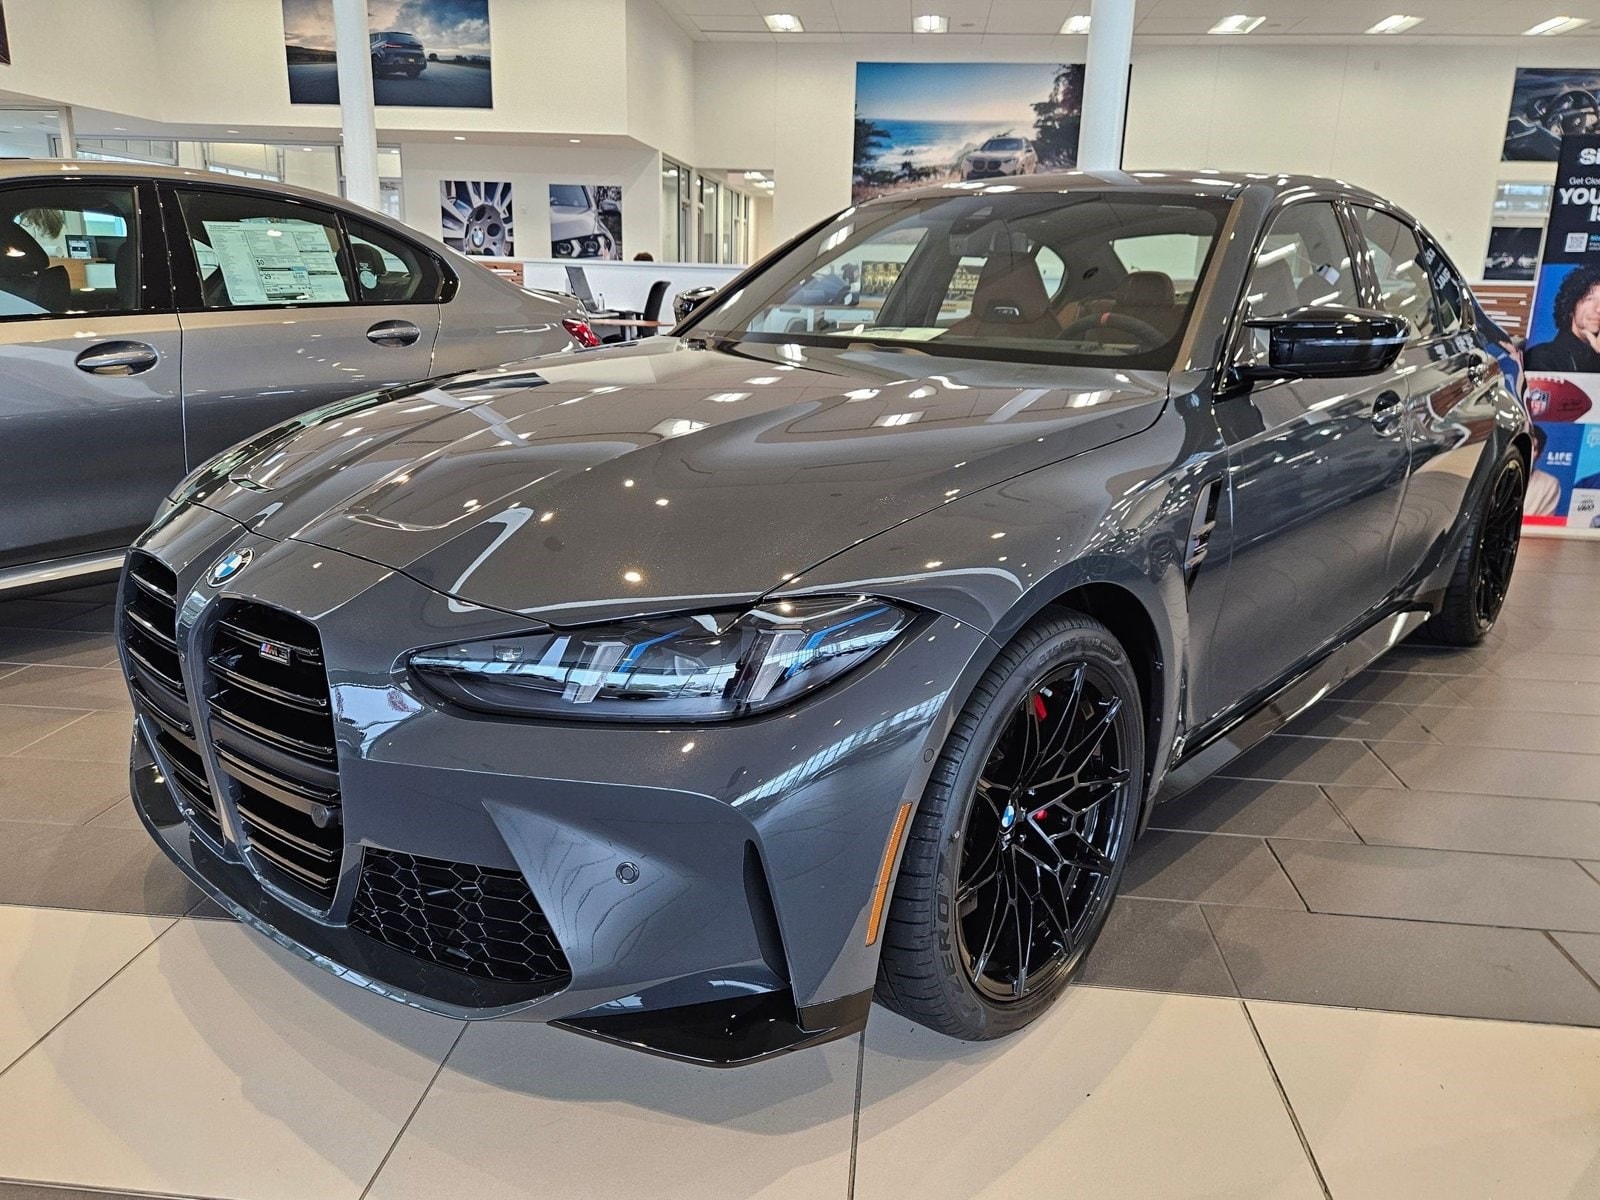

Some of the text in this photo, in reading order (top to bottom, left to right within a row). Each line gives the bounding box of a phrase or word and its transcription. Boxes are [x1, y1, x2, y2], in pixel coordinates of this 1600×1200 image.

[1590, 205, 1600, 222] I
[1547, 452, 1573, 462] LIFE
[937, 894, 964, 994] ZERO
